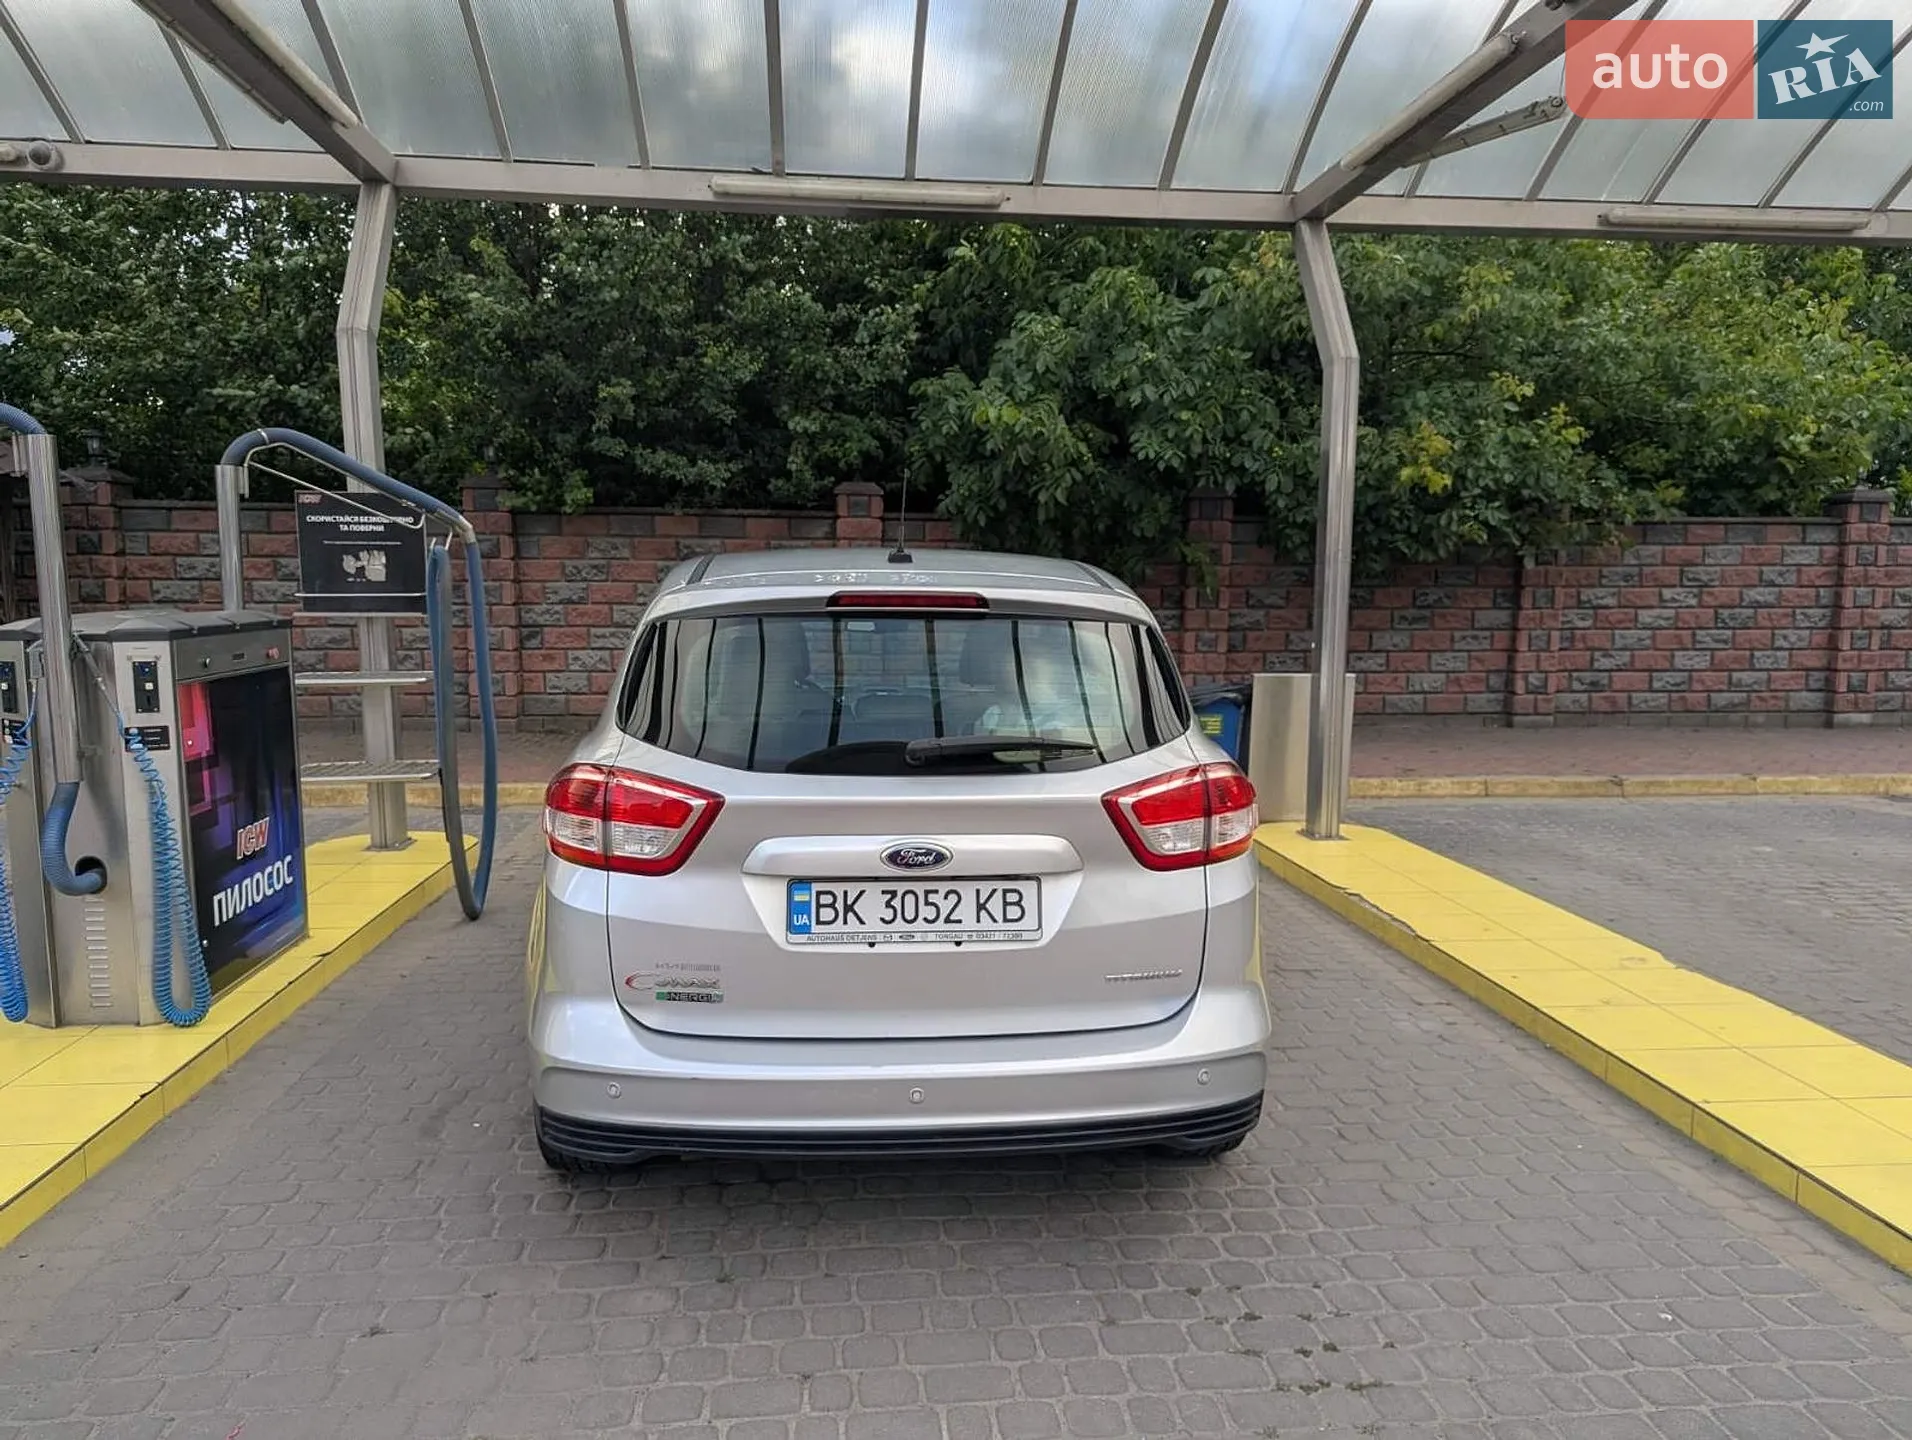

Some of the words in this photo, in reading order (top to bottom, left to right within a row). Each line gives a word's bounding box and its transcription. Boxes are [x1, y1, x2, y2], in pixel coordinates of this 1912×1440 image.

[897, 848, 937, 866] Ford
[213, 854, 293, 927] ПИЛОСОС
[793, 914, 810, 926] UA
[814, 889, 867, 926] BK
[879, 888, 963, 925] 3052
[975, 887, 1026, 924] KB
